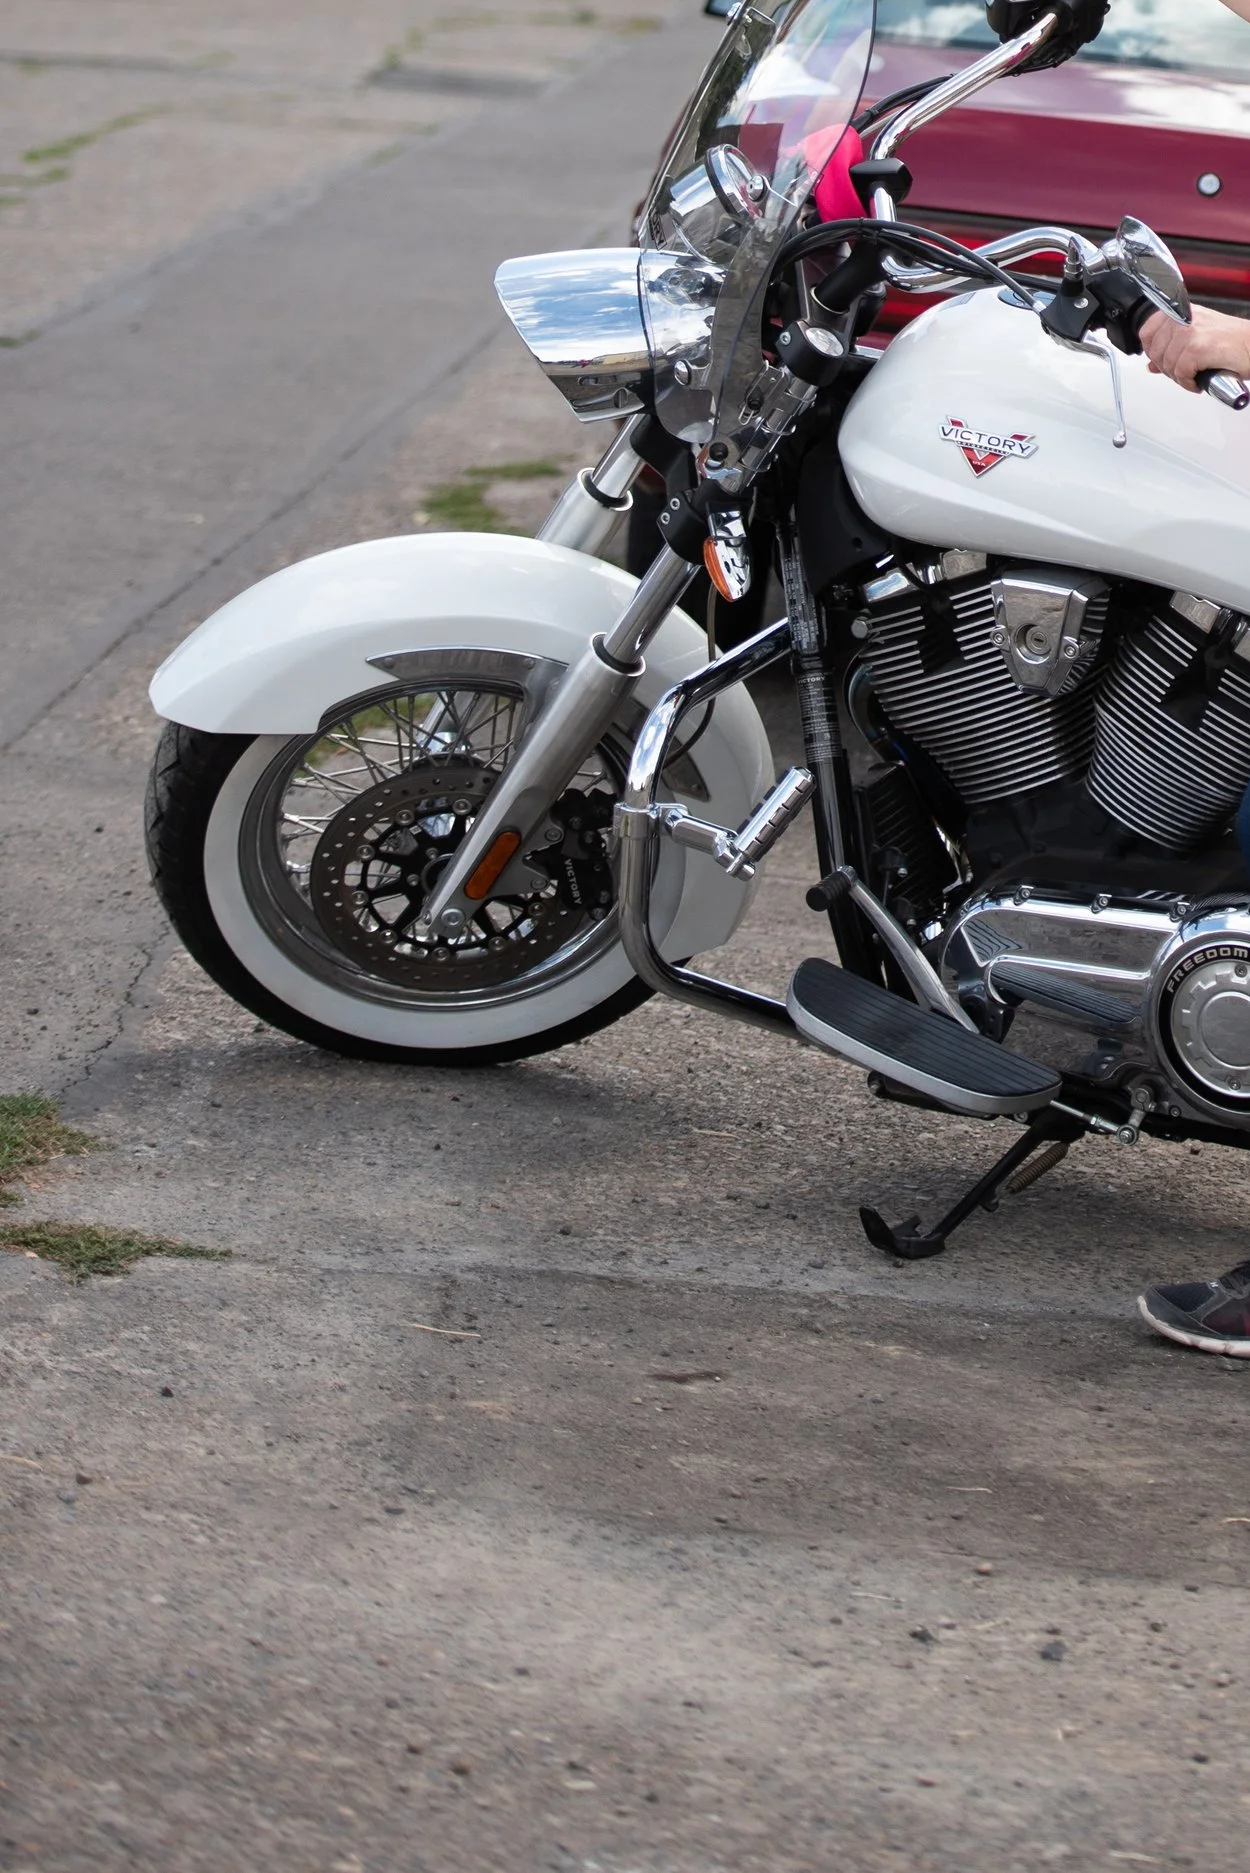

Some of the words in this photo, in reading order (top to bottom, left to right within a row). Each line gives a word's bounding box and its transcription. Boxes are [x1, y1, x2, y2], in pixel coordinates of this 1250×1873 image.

[941, 425, 1031, 455] VICTORY
[564, 858, 582, 905] VICTORY
[1166, 947, 1249, 994] FREEDOM
